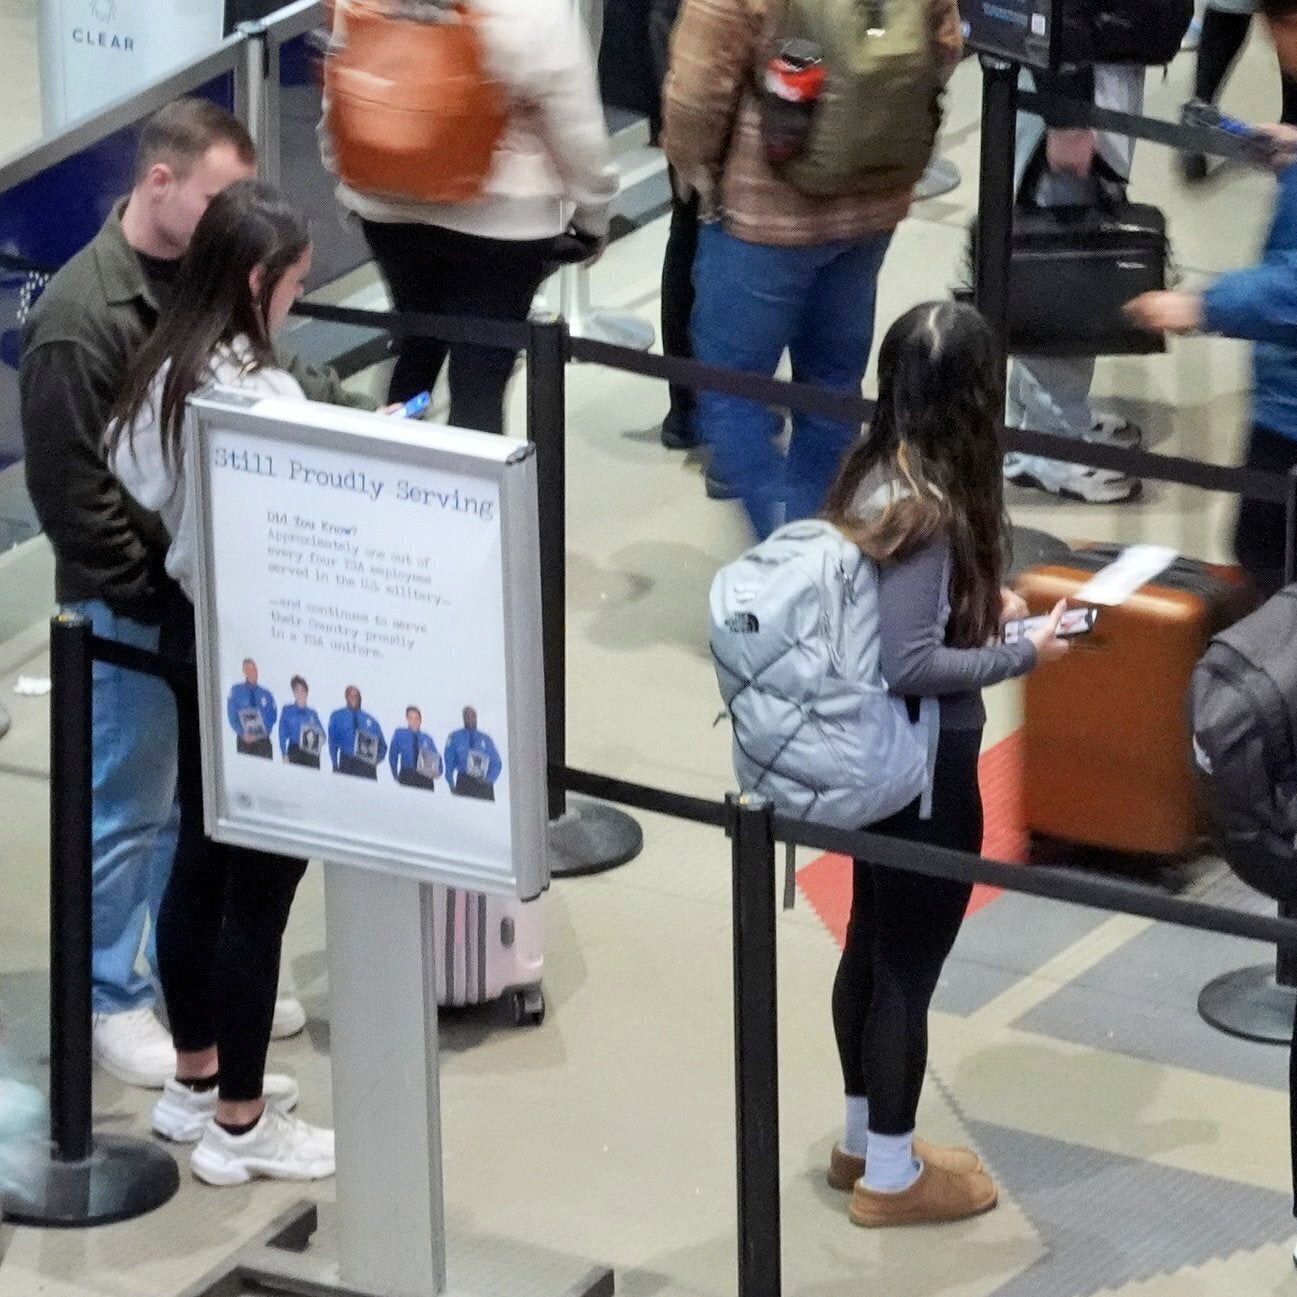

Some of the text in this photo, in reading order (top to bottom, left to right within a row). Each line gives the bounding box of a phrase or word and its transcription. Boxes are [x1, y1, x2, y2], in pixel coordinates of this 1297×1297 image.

[72, 29, 134, 51] CLEAR
[215, 447, 494, 521] Still Proudly Serving
[267, 511, 358, 536] Did You Know?
[267, 527, 430, 568] Approximately one out of
[267, 546, 432, 585] every four TSA employees
[267, 562, 309, 579] served
[316, 569, 329, 582] in
[336, 573, 355, 587] the
[271, 610, 415, 651] their Country proudly
[375, 614, 388, 626] to
[392, 620, 428, 633] serve
[271, 626, 285, 640] in
[303, 634, 324, 647] TSA
[329, 640, 384, 657] uniform.
